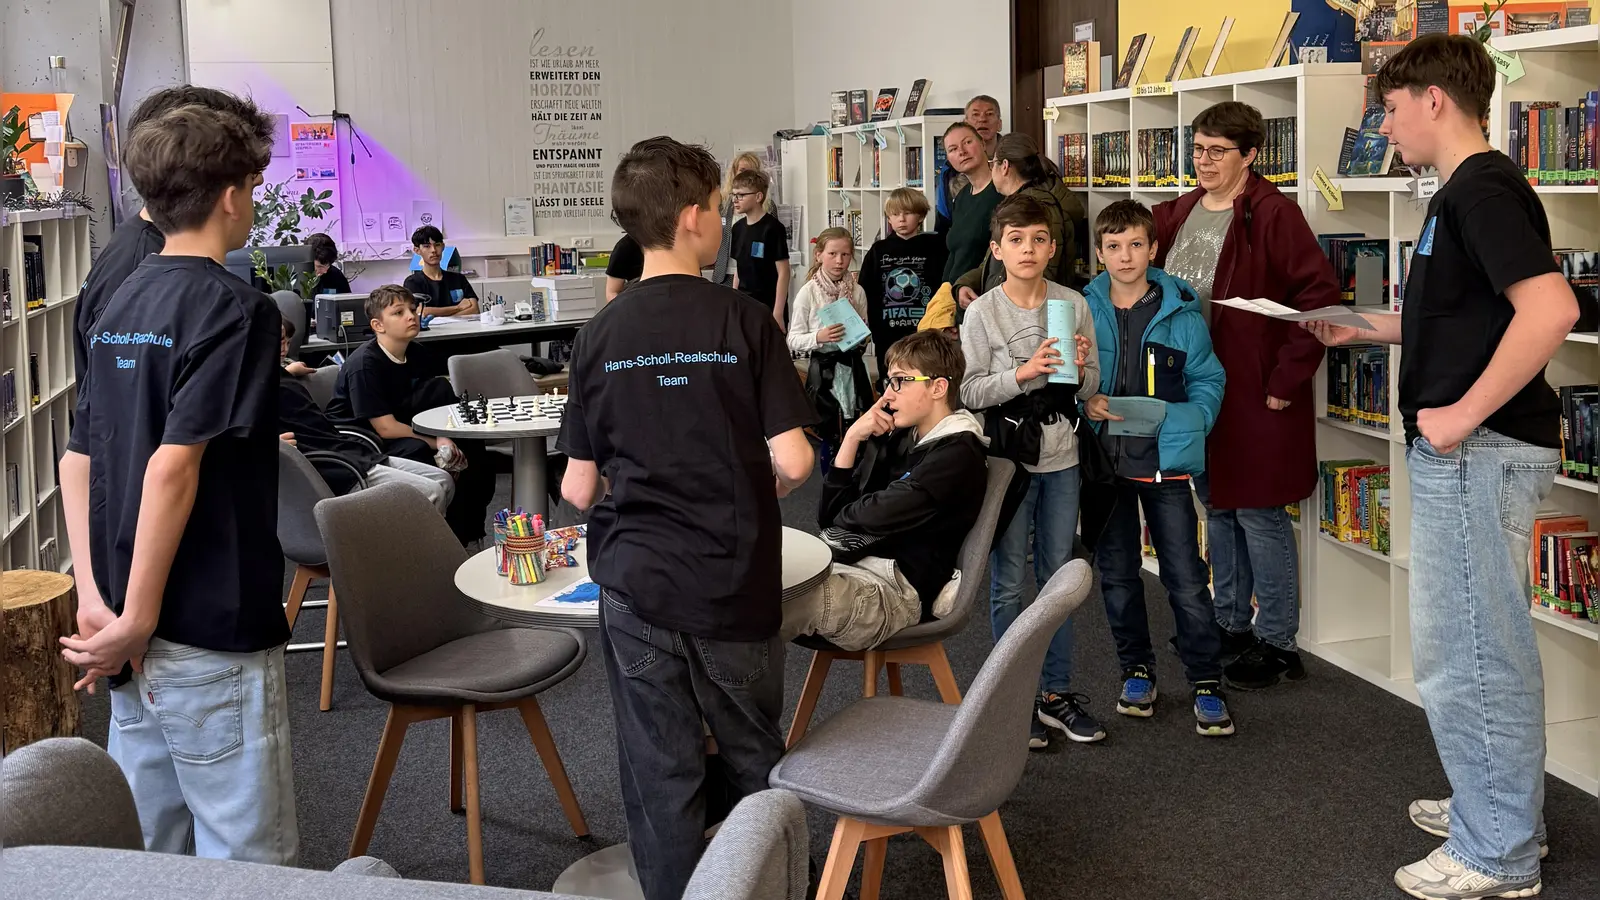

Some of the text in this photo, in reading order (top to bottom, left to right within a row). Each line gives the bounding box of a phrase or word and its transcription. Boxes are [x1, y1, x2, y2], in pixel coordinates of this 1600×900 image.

[528, 27, 598, 58] lesen
[530, 59, 600, 68] IST WIE URLAUB AM MEER
[530, 72, 601, 80] ERWEITERT DEN
[530, 84, 601, 96] HORIZONT
[530, 100, 602, 110] ERSCHAFFT NEUE WELTEN
[532, 110, 552, 120] HÄLT
[590, 112, 602, 120] AN
[533, 123, 600, 145] Träume
[533, 149, 603, 160] ENTSPANNT
[534, 182, 605, 194] PHANTASIE
[535, 196, 605, 207] LÄSST DIE SEELE
[116, 356, 136, 368] Team
[604, 351, 738, 372] Hans-Scholl-Realschule
[657, 376, 688, 386] Team
